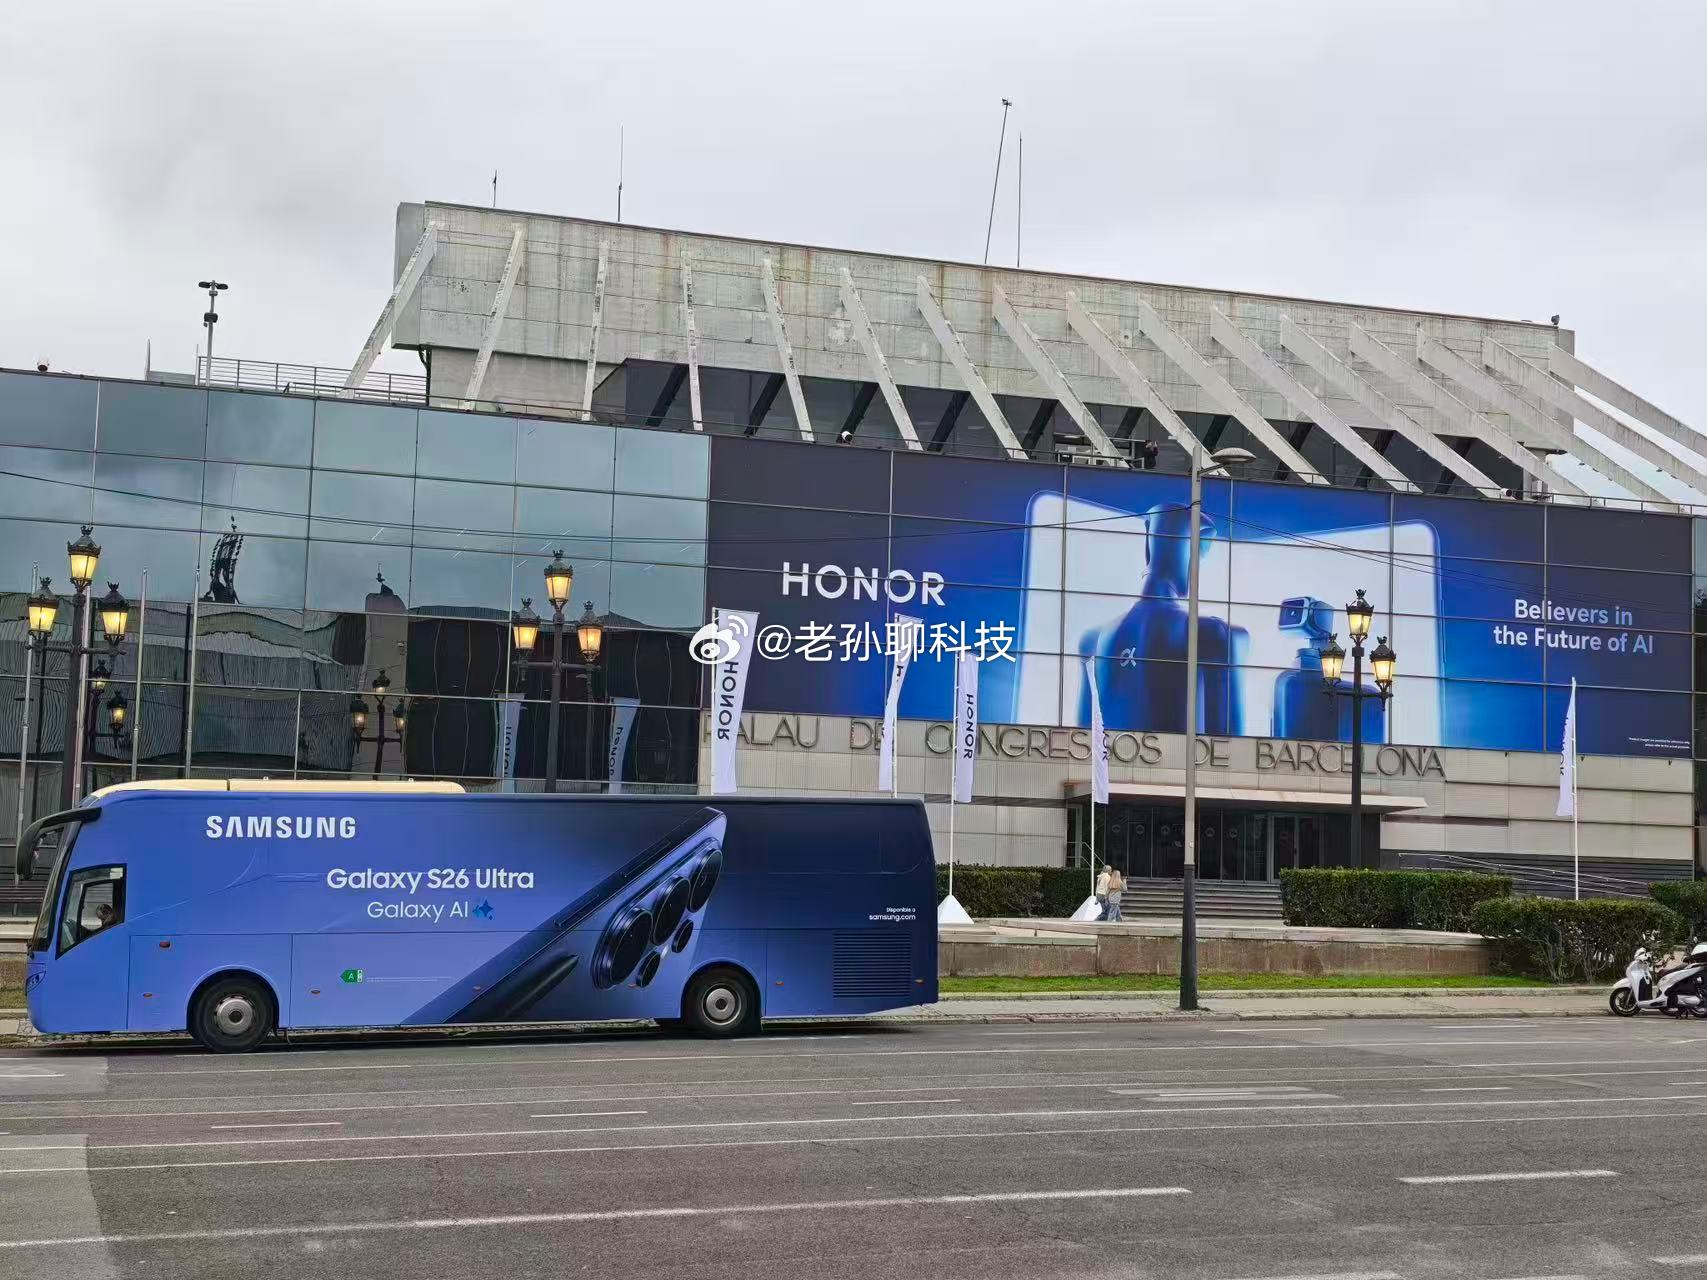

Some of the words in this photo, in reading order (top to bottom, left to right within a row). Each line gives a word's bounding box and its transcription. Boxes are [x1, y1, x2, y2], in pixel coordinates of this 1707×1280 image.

[781, 562, 945, 606] HONOR
[1514, 599, 1608, 624] Believers
[1615, 606, 1633, 626] in
[1493, 625, 1528, 646] the
[1534, 628, 1601, 651] Future
[1607, 632, 1628, 652] of
[1632, 634, 1653, 654] AI
[963, 693, 975, 759] HONOR
[925, 724, 1163, 764] CNGRESOS
[1256, 739, 1445, 777] BARCELONA
[206, 815, 356, 839] SAMSUNG
[327, 868, 423, 895] Galaxy
[426, 868, 470, 889] S26
[475, 868, 534, 889] Ultra
[367, 901, 445, 923] Galaxy
[449, 901, 468, 918] AI
[869, 914, 916, 922] samsung.com
